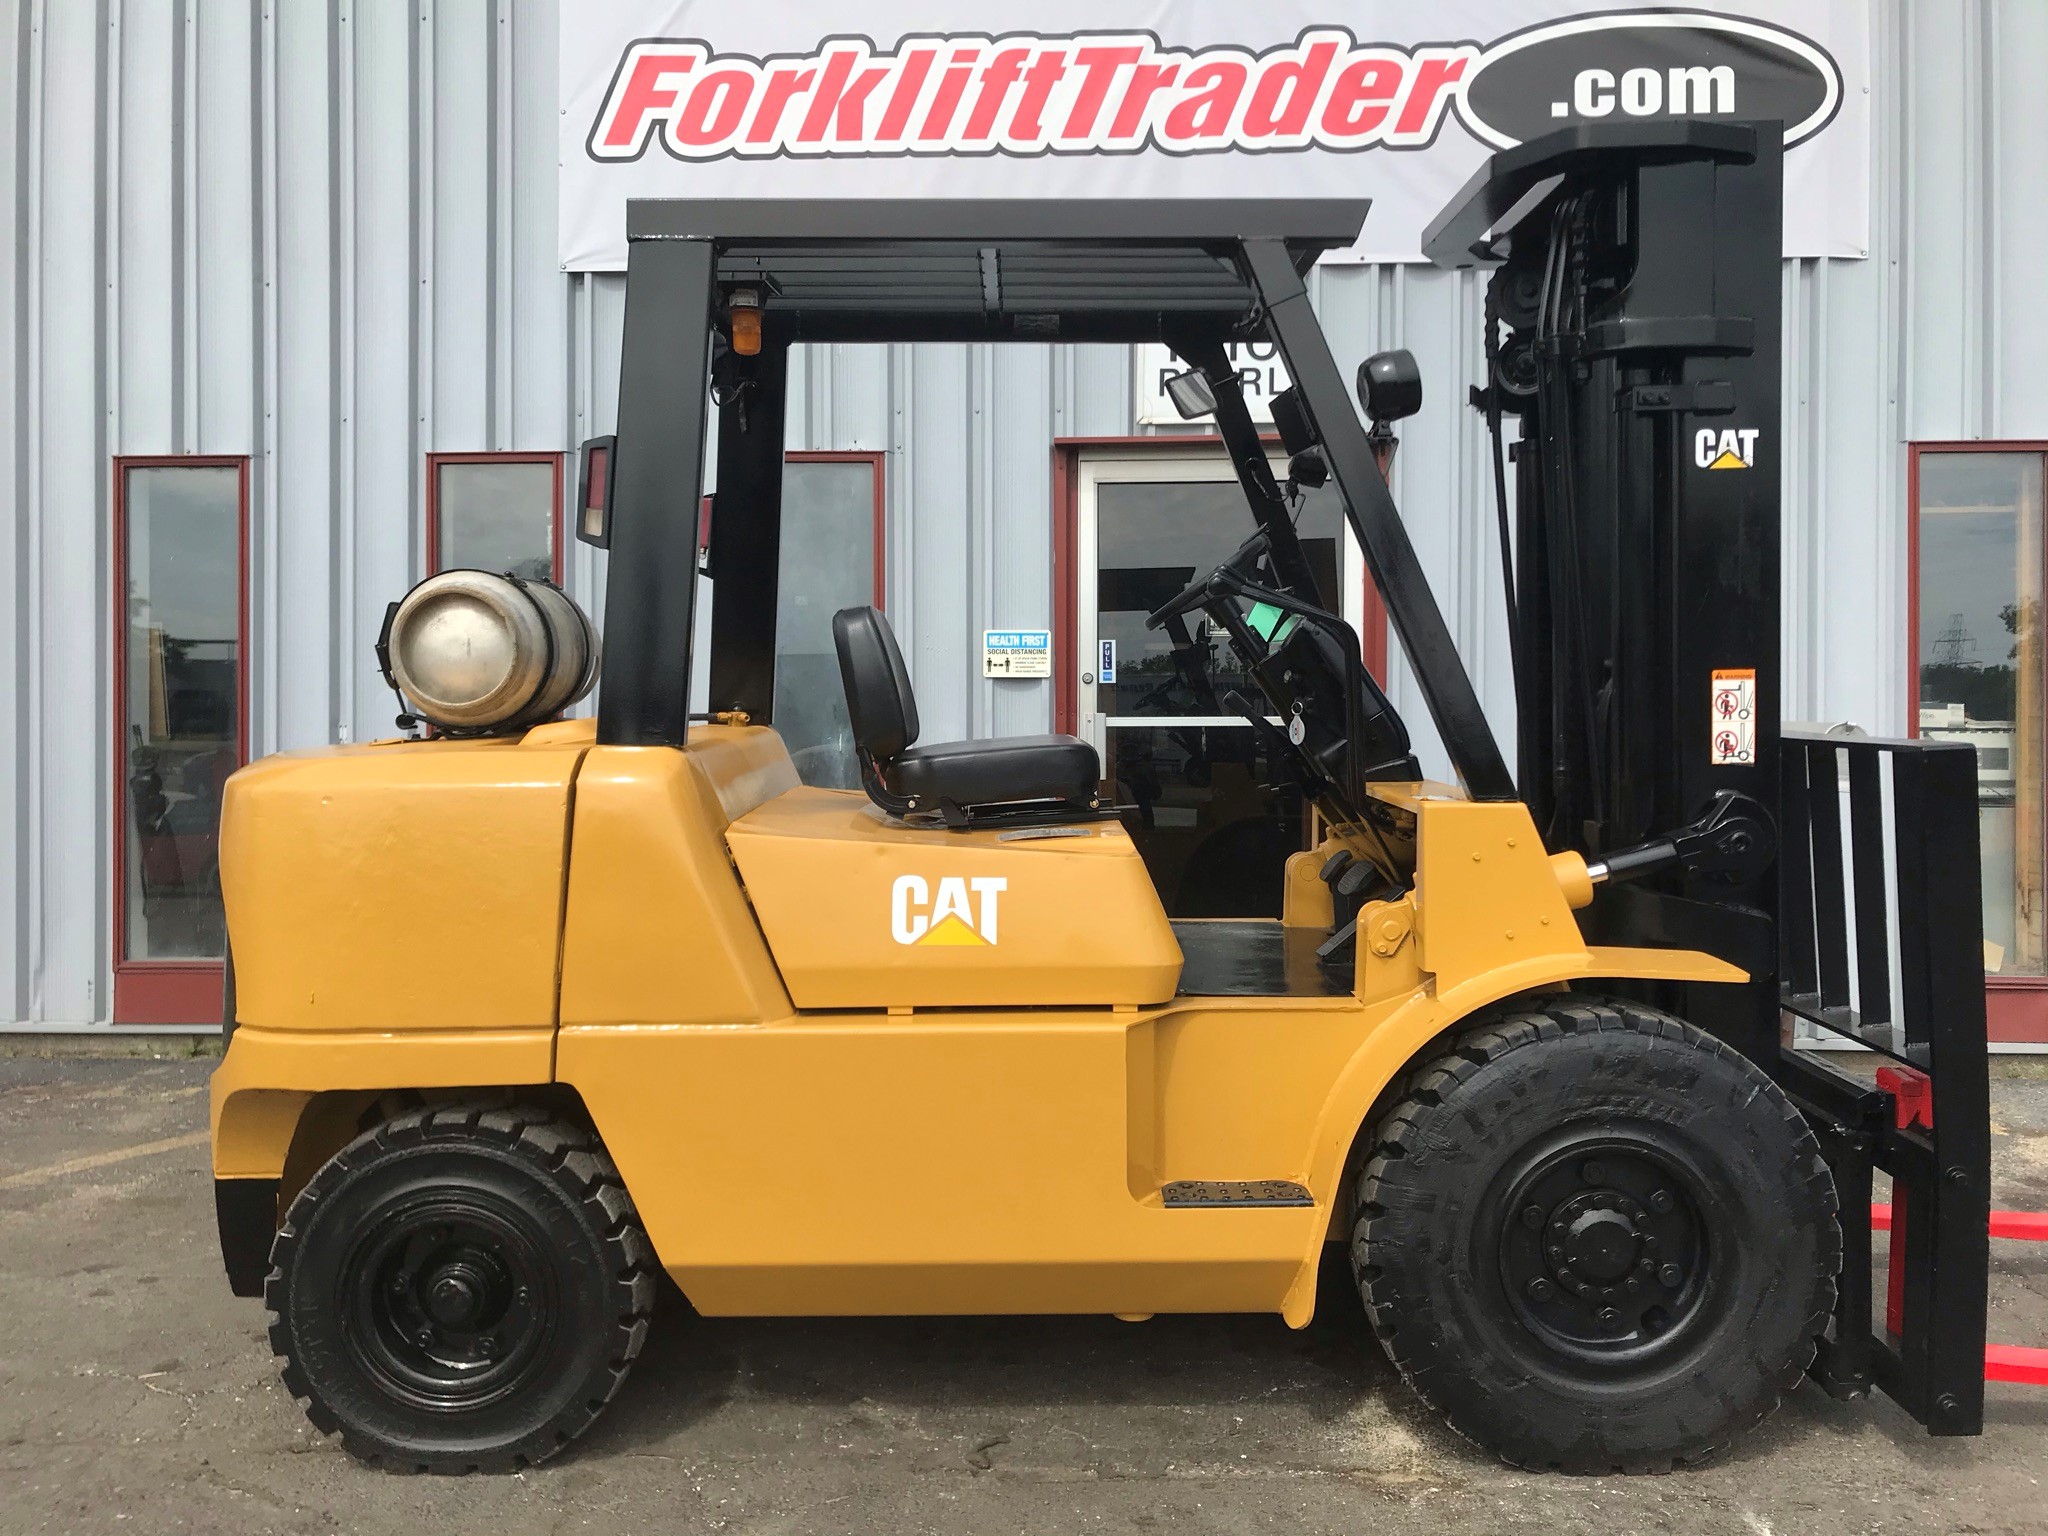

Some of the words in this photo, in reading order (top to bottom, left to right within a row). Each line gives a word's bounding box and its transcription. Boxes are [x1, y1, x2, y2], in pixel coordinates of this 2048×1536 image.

[1694, 428, 1760, 470] CAT
[988, 634, 1021, 647] HEALTH
[1021, 634, 1046, 647] FIRST
[891, 874, 1008, 946] CAT
